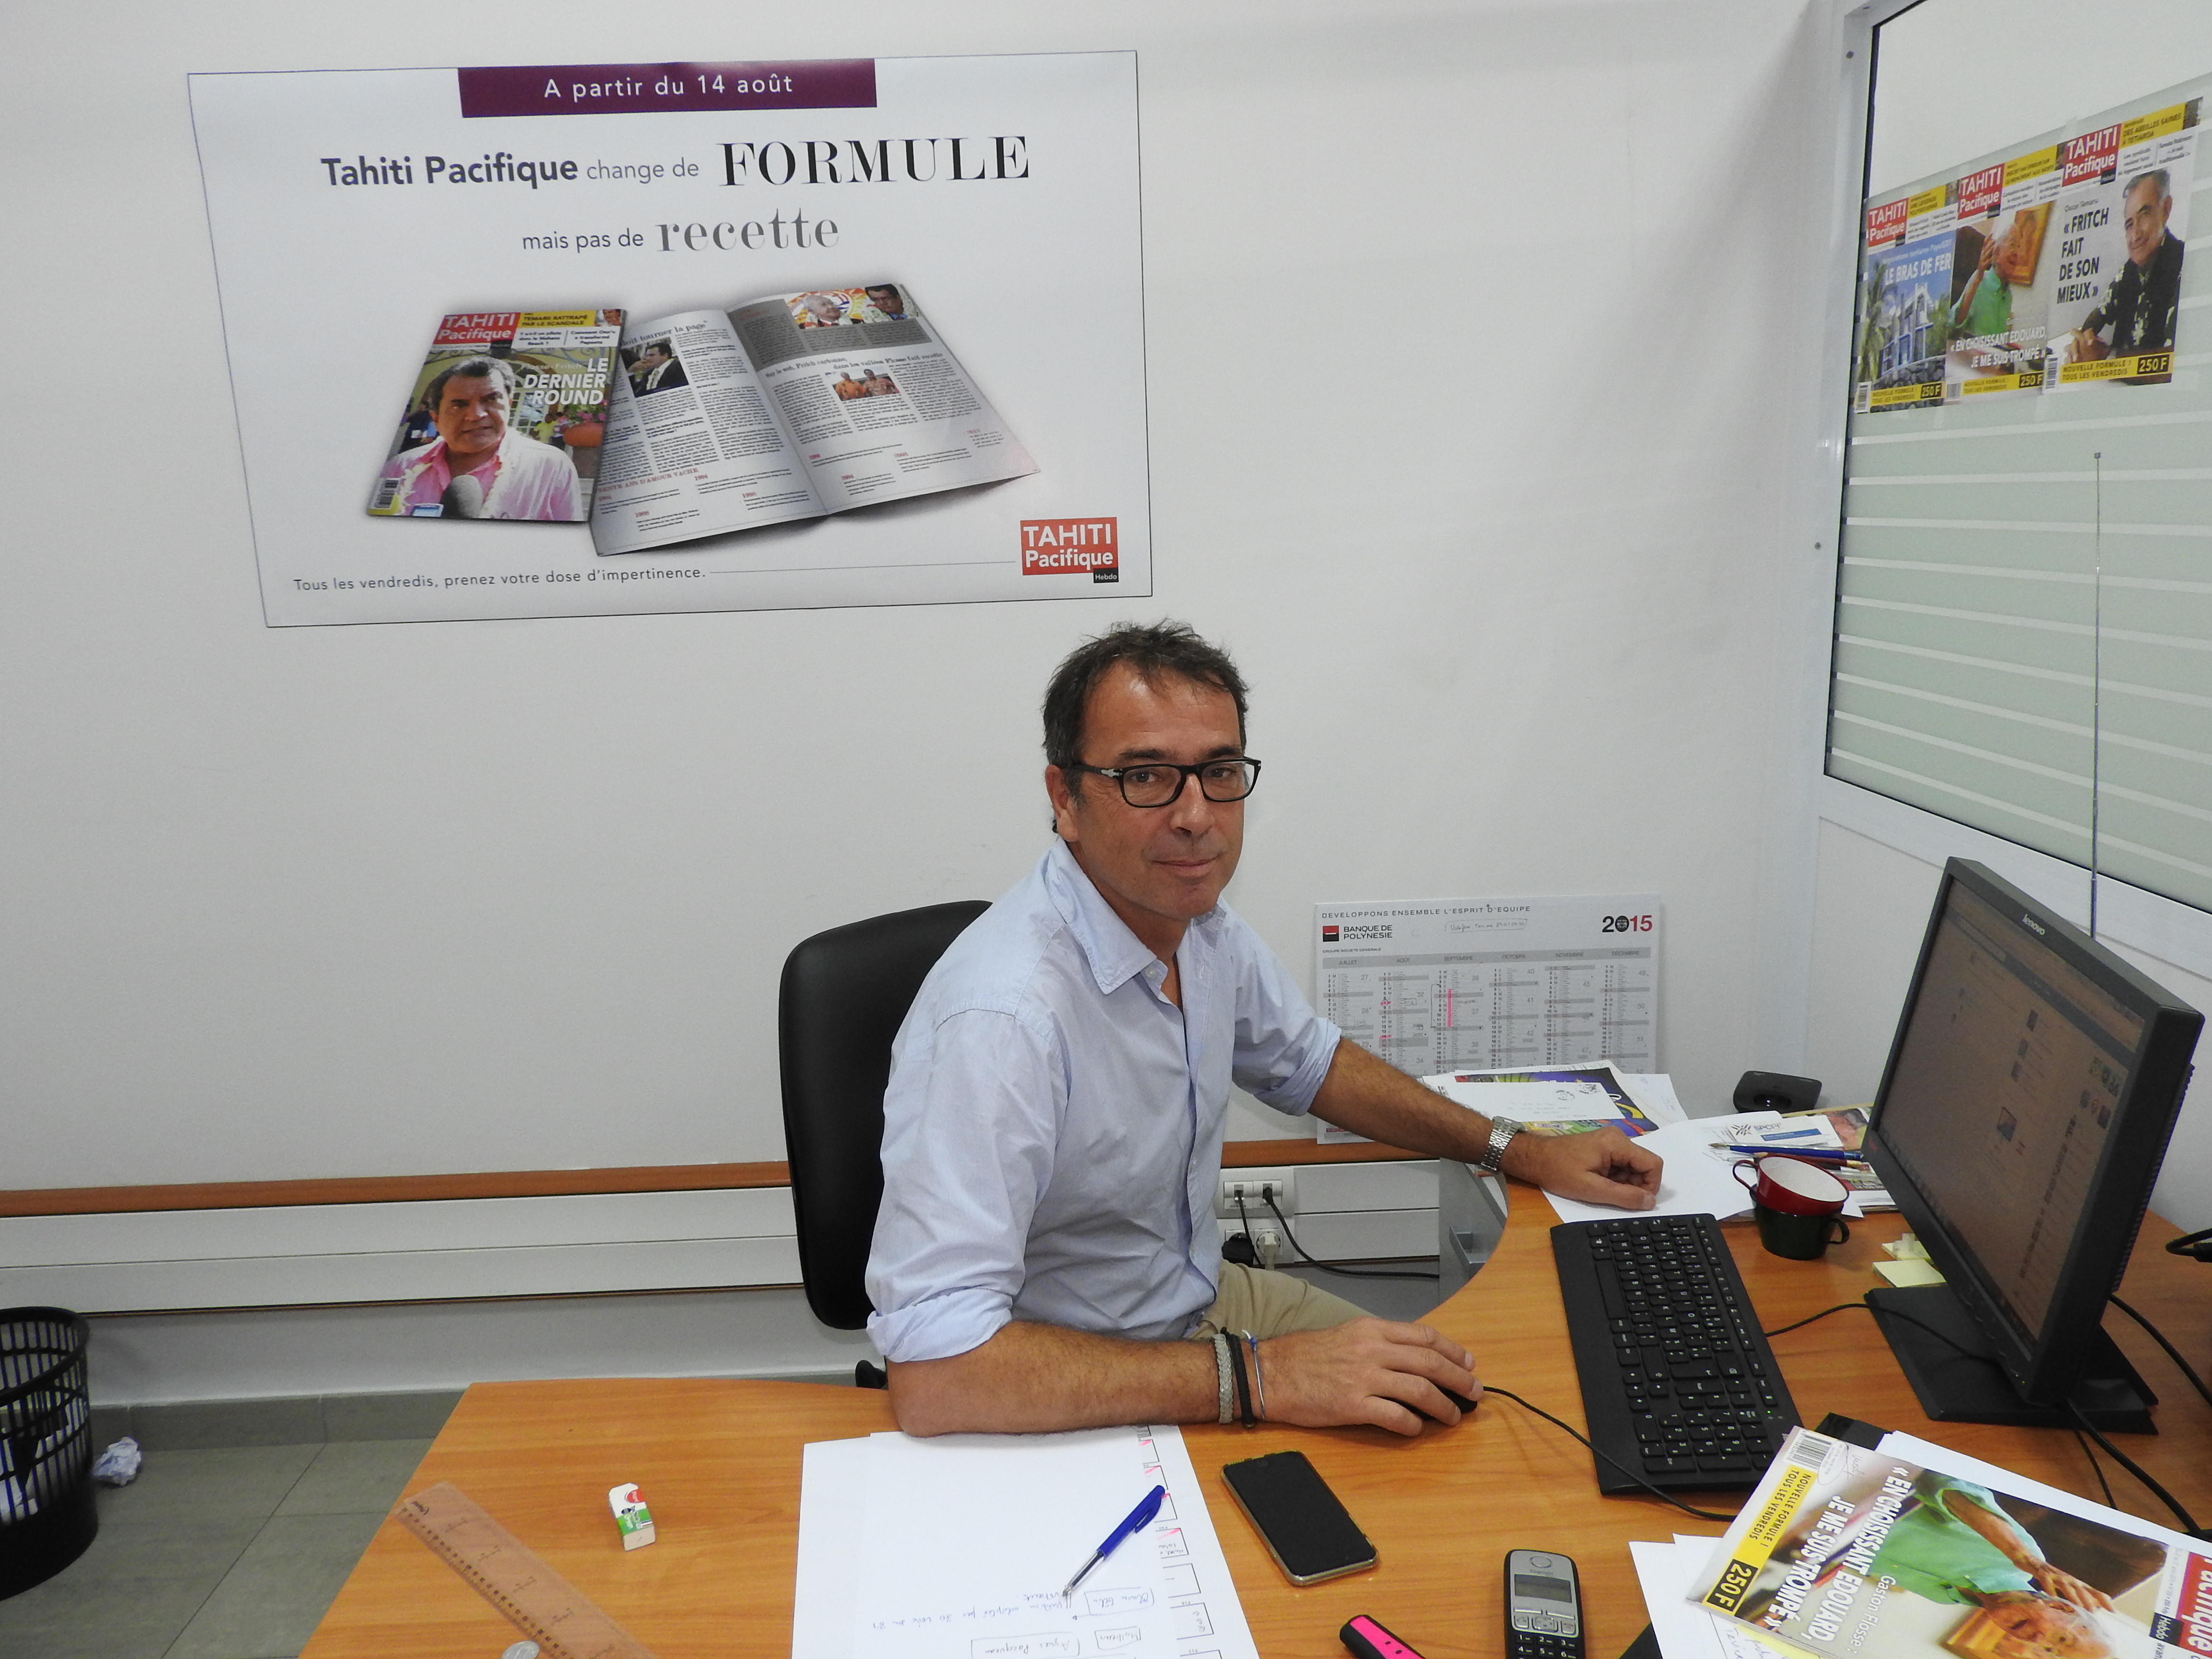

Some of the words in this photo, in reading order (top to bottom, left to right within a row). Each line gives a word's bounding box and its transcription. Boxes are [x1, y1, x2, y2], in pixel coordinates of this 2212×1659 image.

[544, 79, 561, 97] A
[573, 78, 642, 103] partir
[654, 75, 685, 96] du
[697, 74, 726, 95] 14
[737, 73, 793, 95] août
[2067, 126, 2118, 160] TAHITI
[321, 156, 413, 186] Tahiti
[425, 152, 578, 189] Pacifique
[587, 160, 664, 184] change
[672, 157, 699, 178] de
[716, 135, 1029, 186] FORMULE
[2065, 153, 2116, 180] Pacifique
[1961, 167, 2002, 196] TAHITI
[1869, 200, 1907, 227] TAHITI
[1960, 191, 2000, 214] Pacifique
[522, 230, 568, 251] mais
[576, 231, 611, 253] pas
[618, 228, 644, 248] de
[656, 208, 840, 252] recette
[2071, 207, 2110, 233] FRITCH
[2061, 237, 2084, 258] FAIT
[1885, 267, 1895, 286] LE
[1896, 261, 1919, 283] BRAS
[1920, 257, 1934, 276] DE
[1934, 252, 1952, 273] FER
[2059, 262, 2073, 281] DE
[2076, 256, 2100, 278] SON
[2057, 281, 2092, 304] MIEUX
[445, 313, 516, 328] TAHITI
[437, 328, 512, 342] Pacifique
[587, 358, 609, 373] LE
[2063, 363, 2094, 373] NOUVELLE
[2095, 360, 2126, 370] FORMULE
[2091, 369, 2128, 378] VENDREDIS
[2139, 358, 2159, 373] 250
[2160, 357, 2168, 371] F
[523, 373, 606, 389] DERNIER
[1921, 385, 1935, 397] 250
[1935, 384, 1941, 396] F
[2020, 374, 2036, 387] 250
[531, 389, 603, 405] ROUND
[1023, 523, 1111, 547] TAHITI
[1025, 548, 1114, 571] Pacifique
[294, 578, 328, 591] Tous
[333, 577, 355, 589] les
[359, 575, 439, 589] vendredis,
[444, 575, 496, 589] prenez
[501, 573, 540, 584] votre
[545, 570, 581, 583] dose
[587, 567, 706, 584] d'impertinence.
[1322, 911, 1389, 919] DEVELOPPONS
[1602, 914, 1653, 933] 2015
[2022, 914, 2045, 936] lenovo
[1344, 932, 1393, 940] POLYNESIE
[1782, 1470, 1800, 1488] TOUS
[1882, 1476, 1913, 1498] EN
[1774, 1489, 1789, 1502] LES
[1784, 1474, 1812, 1509] NOUVELLE
[1827, 1495, 1856, 1515] JE
[1749, 1503, 1779, 1540] VENDREDIS
[1763, 1509, 1790, 1542] FORMULE
[1816, 1510, 1849, 1535] ME
[1800, 1530, 1837, 1563] SUIS
[1842, 1495, 1903, 1575] CHOISISSANT
[1720, 1563, 1753, 1595] 250
[1768, 1559, 1822, 1622] TROMPÉ
[1714, 1592, 1735, 1608] F
[1867, 1575, 1897, 1612] Gaston
[1801, 1570, 1863, 1642] EDOUARD,
[1851, 1613, 1879, 1647] Flosse
[2155, 1615, 2172, 1640] Hebdo
